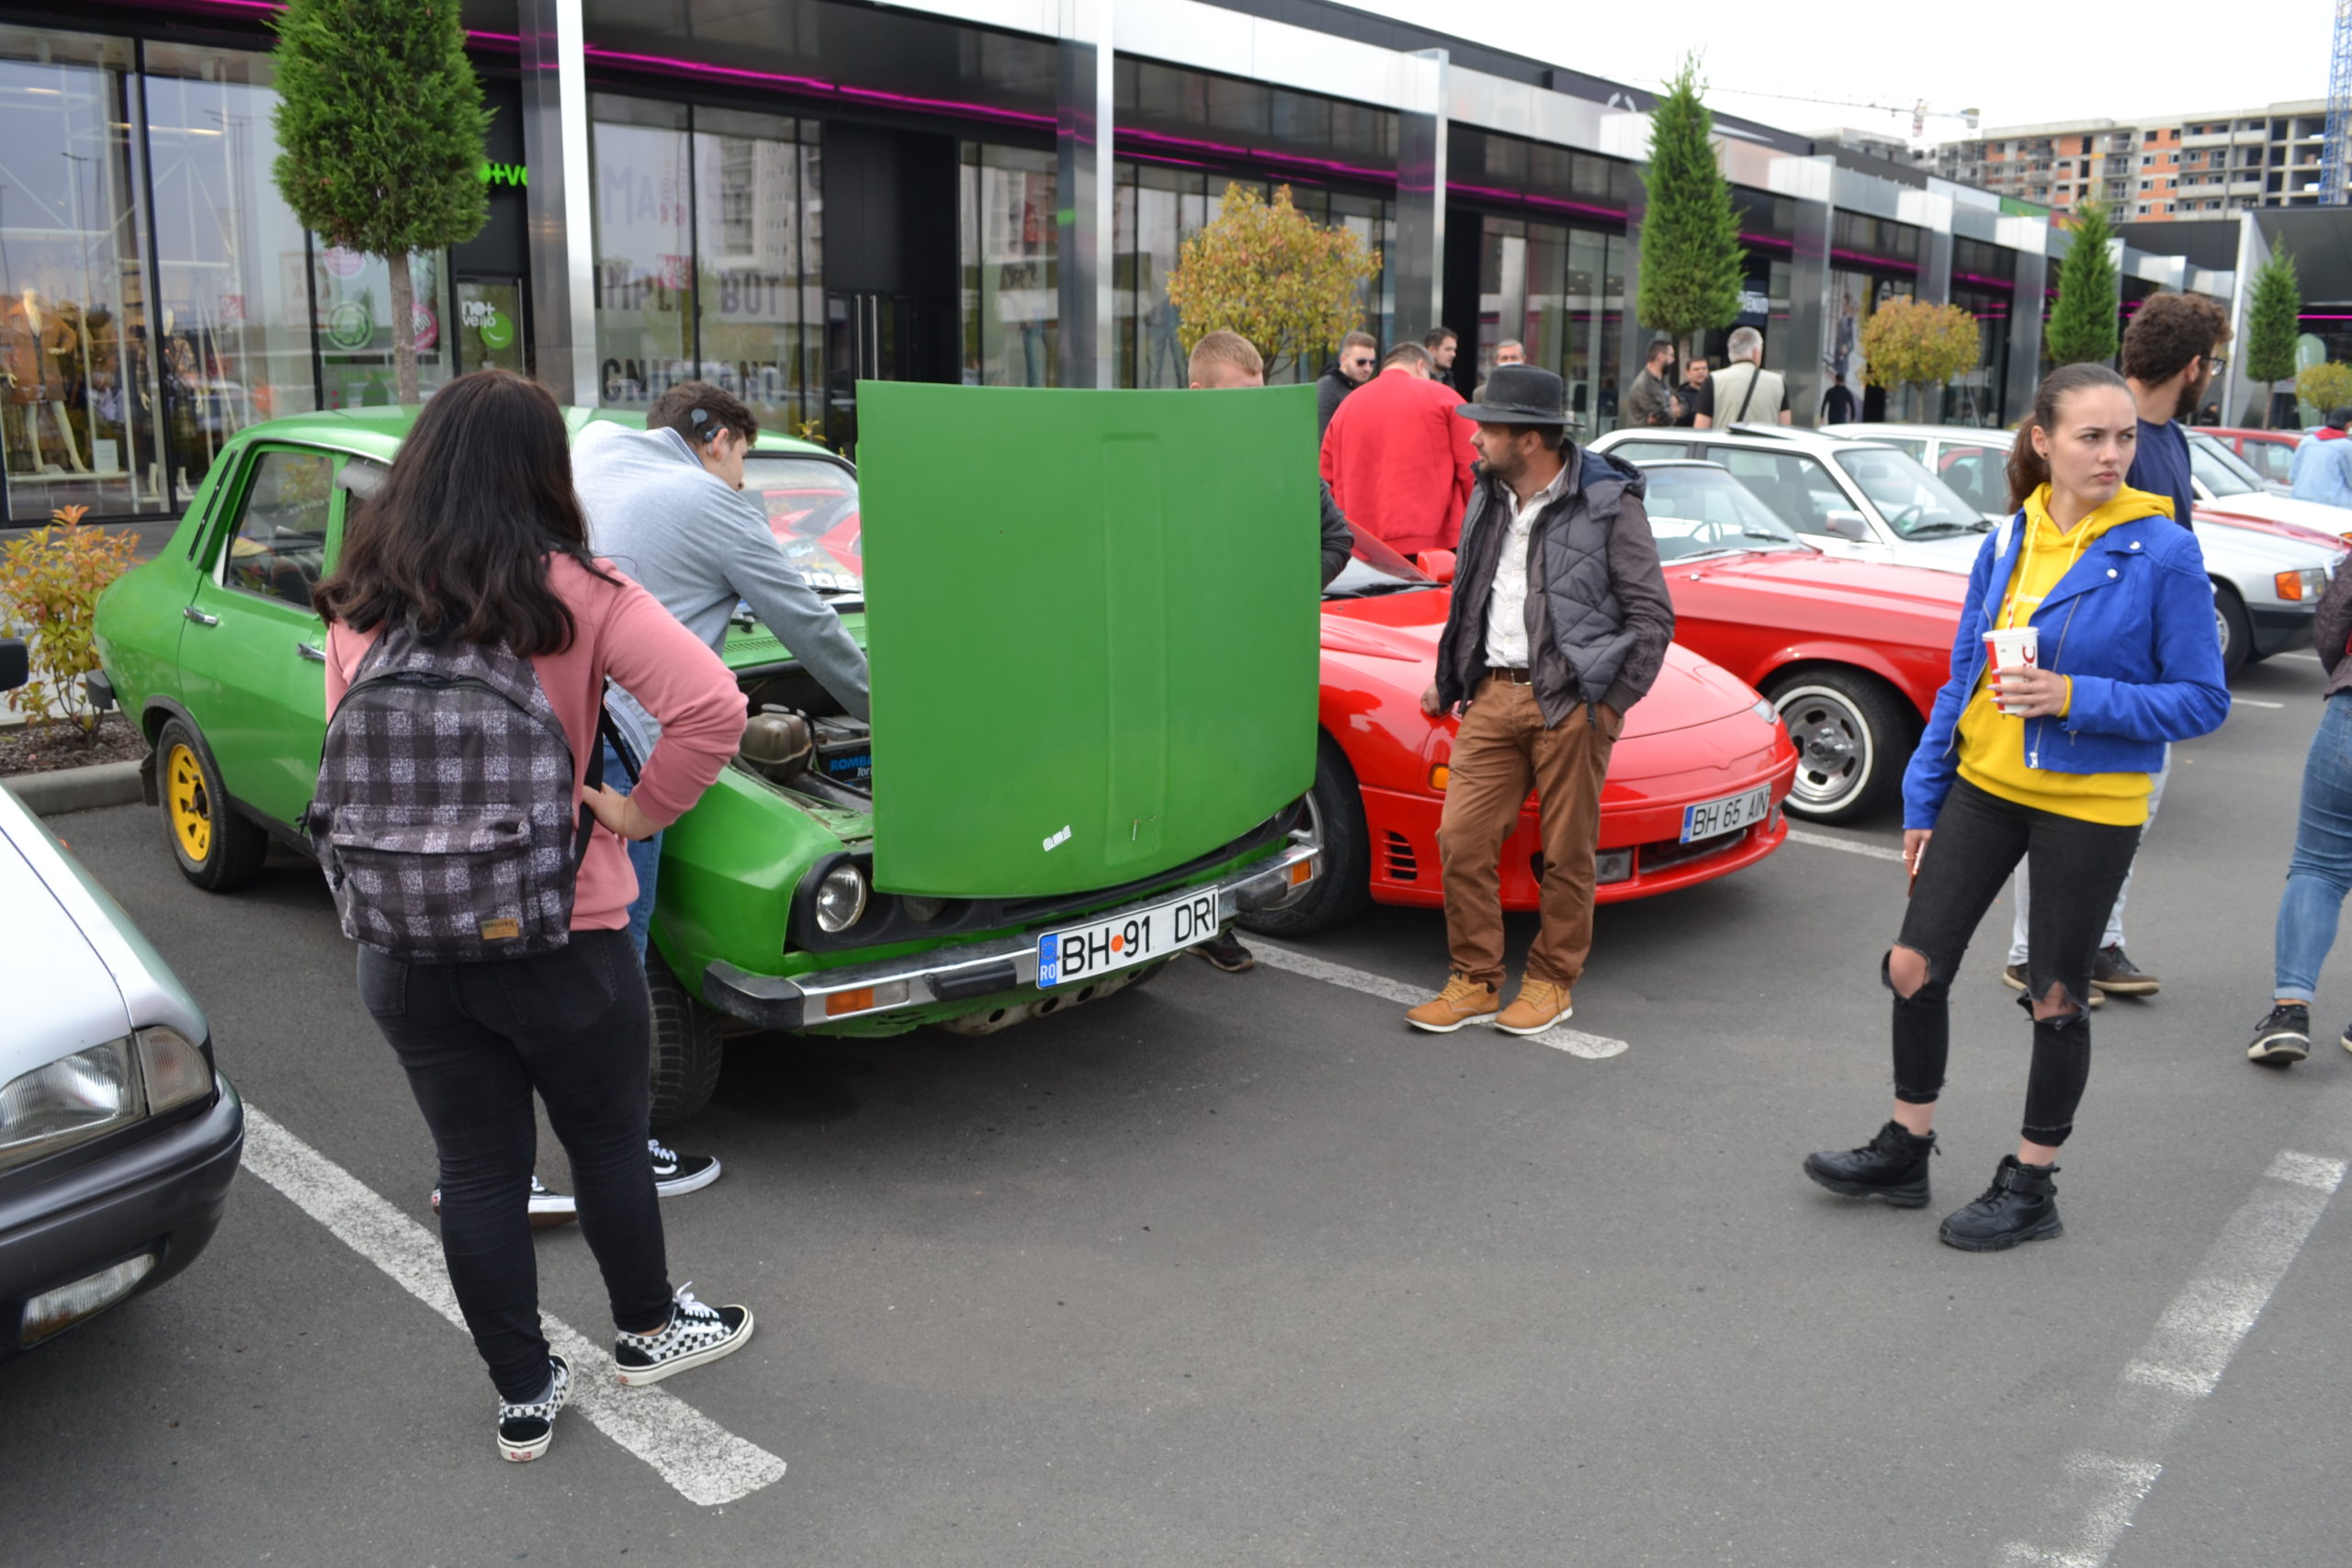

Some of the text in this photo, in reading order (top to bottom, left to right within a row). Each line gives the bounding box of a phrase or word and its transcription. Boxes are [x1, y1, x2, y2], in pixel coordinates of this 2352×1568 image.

[720, 271, 780, 316] BUT
[857, 767, 873, 777] Tor
[1692, 790, 1770, 837] BH 65 AIN
[1040, 893, 1216, 982] RO BH 91 DRI
